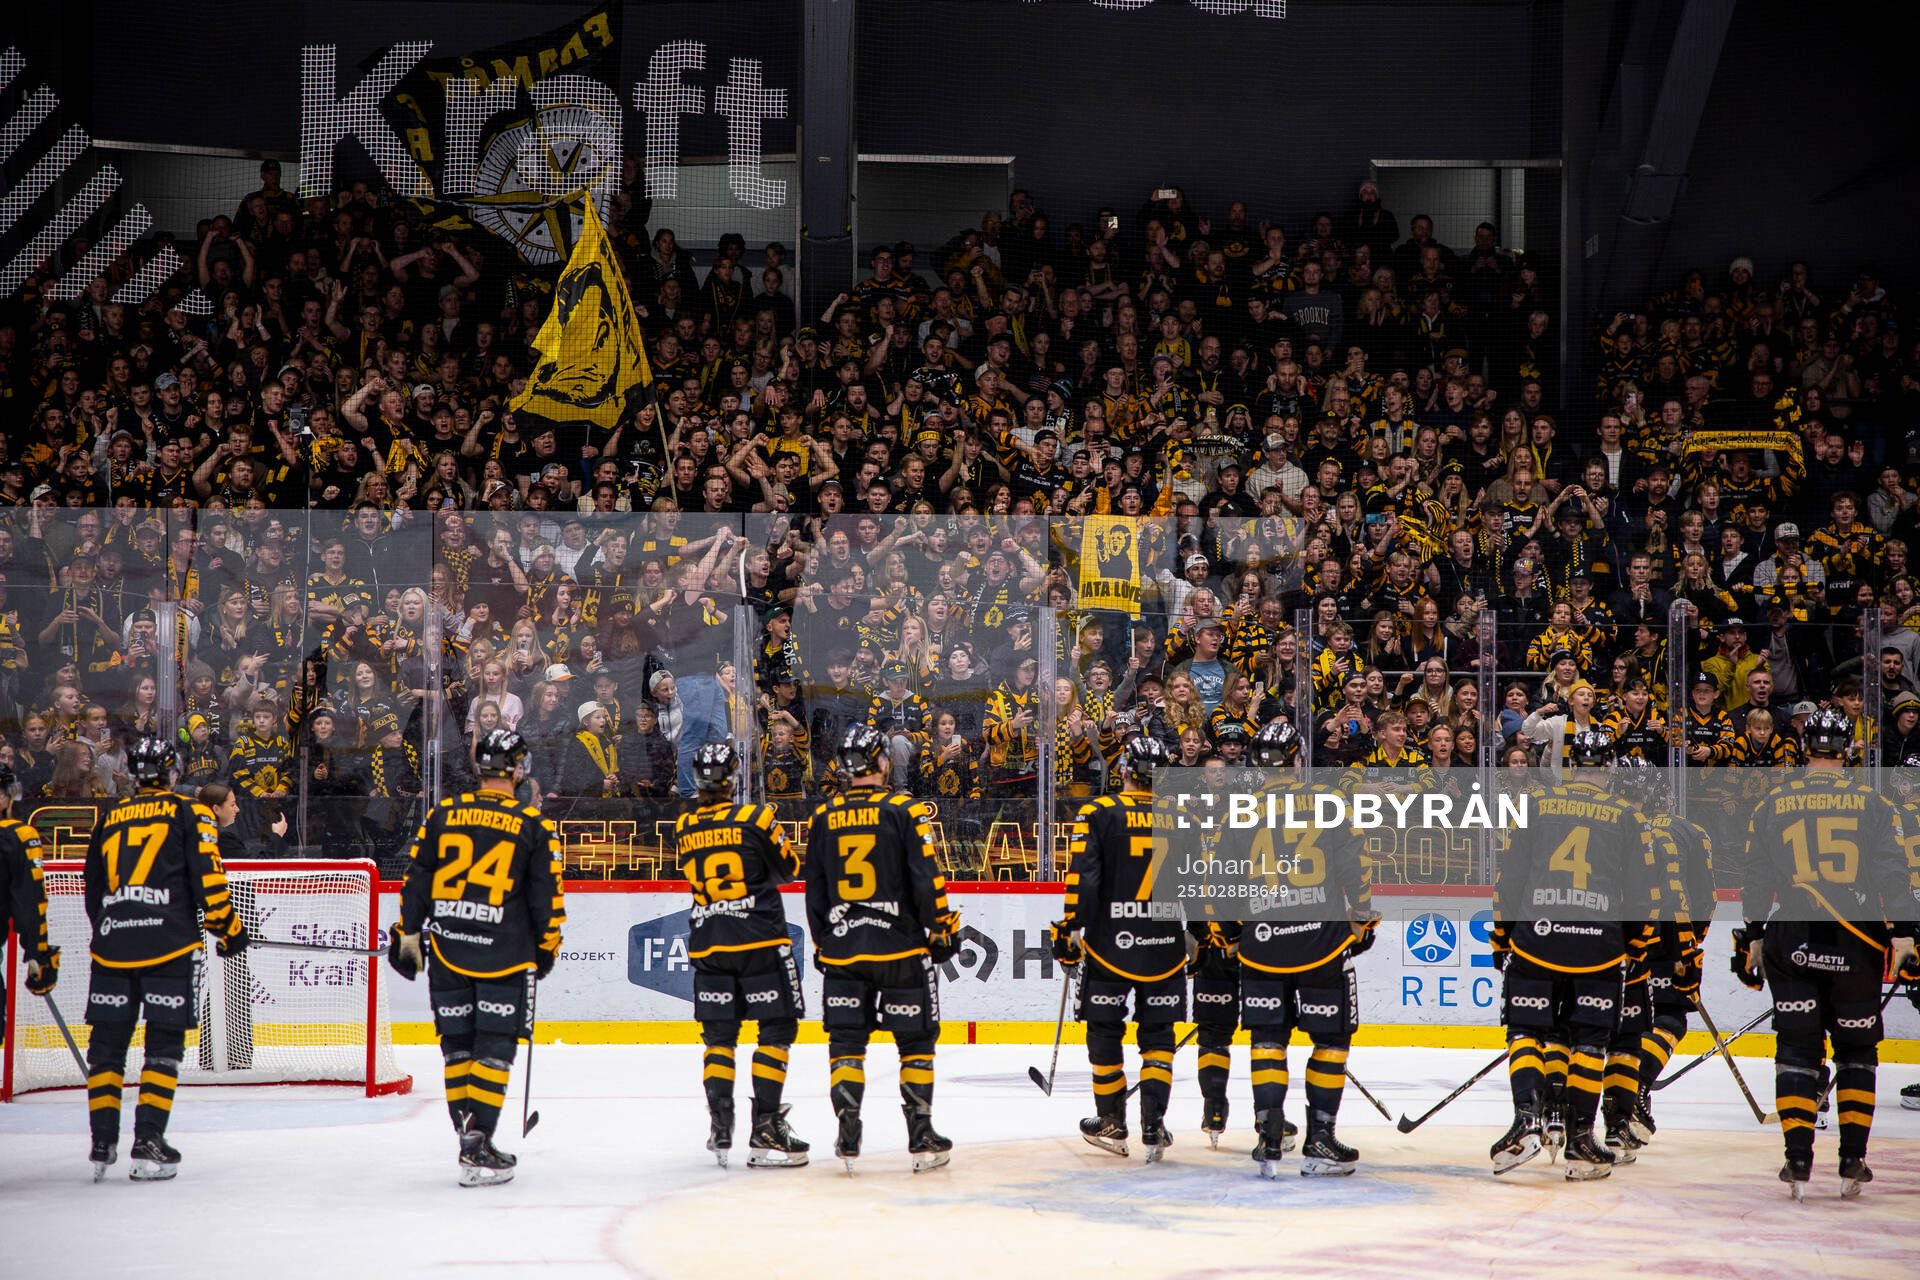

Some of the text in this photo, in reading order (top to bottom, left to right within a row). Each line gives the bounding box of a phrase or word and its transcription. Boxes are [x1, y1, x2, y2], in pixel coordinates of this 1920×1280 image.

[300, 39, 788, 210] Kraft
[1538, 798, 1622, 824] BERGQVIST
[1775, 793, 1866, 814] BRYGGMAN
[445, 808, 523, 835] LINDBERG
[828, 807, 880, 830] GRAHN
[1126, 811, 1174, 830] HAARA
[678, 827, 743, 855] LINDBERG
[101, 822, 169, 894] 17
[1248, 820, 1327, 893] 43
[1549, 825, 1592, 890] 4
[1782, 816, 1860, 884] 15
[431, 832, 517, 906] 24
[837, 833, 877, 901] 3
[1129, 835, 1169, 901] 7
[1249, 886, 1327, 915] BOLIDEN
[1533, 888, 1609, 912] BOLIDEN
[111, 917, 165, 929] Contractor
[848, 916, 893, 929] Contractor
[1273, 921, 1323, 936] Contractor
[1553, 923, 1603, 936] Contractor
[443, 930, 494, 945] Contractor
[557, 952, 616, 961] ROJEKT
[1808, 953, 1845, 965] BASTU
[783, 958, 803, 1011] REPAY
[1402, 976, 1493, 1008] REC
[90, 992, 128, 1008] coop
[145, 992, 186, 1009] coop
[525, 973, 535, 1031] REPAY
[699, 991, 733, 1005] coop
[746, 990, 779, 1004] coop
[827, 996, 861, 1009] coop
[1090, 994, 1126, 1006] coop
[1146, 995, 1180, 1007] coop
[1196, 992, 1232, 1005] coop
[1245, 996, 1281, 1011] coop
[1347, 971, 1358, 1025] REPAY
[1511, 995, 1550, 1011] coop
[1577, 995, 1614, 1011] coop
[438, 1003, 474, 1017] coop
[477, 1000, 515, 1017] coop
[885, 1003, 921, 1018] coop
[1301, 1003, 1339, 1018] coop
[1776, 998, 1817, 1014] coop
[1837, 1014, 1877, 1029] coop
